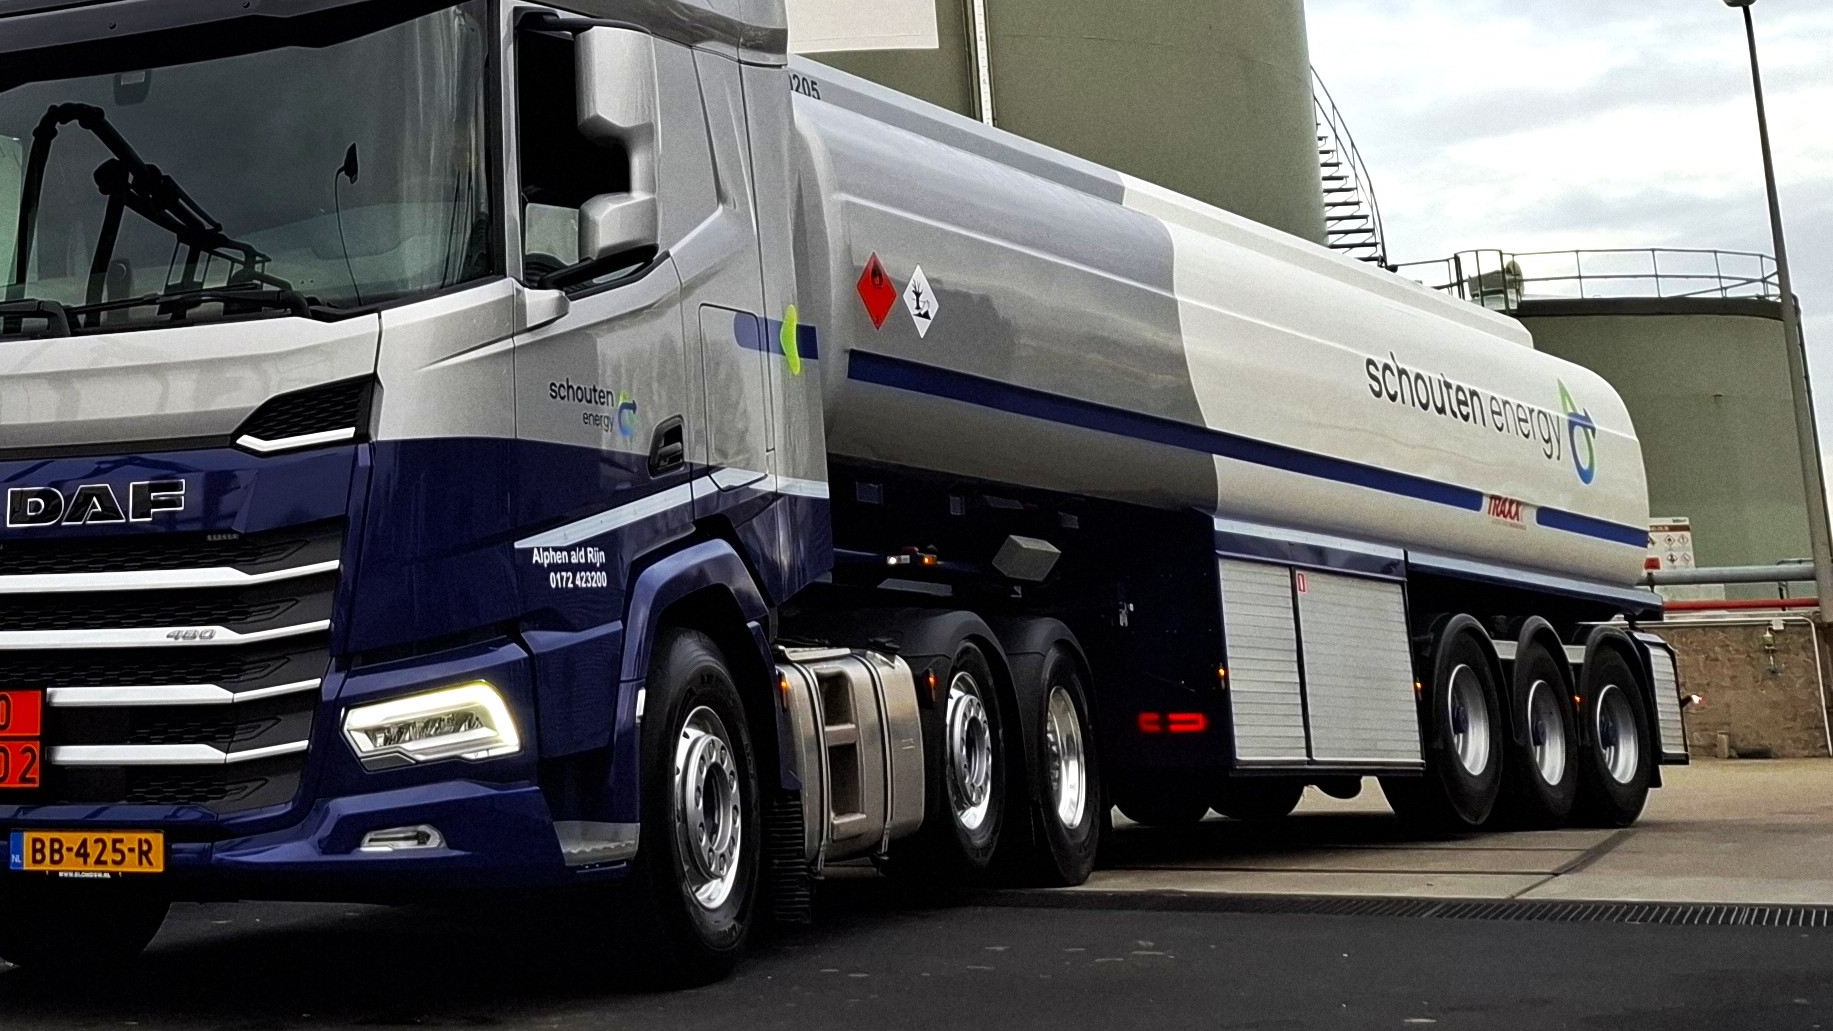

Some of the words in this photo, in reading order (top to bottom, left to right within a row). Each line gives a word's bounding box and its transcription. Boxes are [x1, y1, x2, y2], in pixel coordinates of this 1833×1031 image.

[789, 74, 821, 100] 205
[549, 378, 614, 407] schouten
[1364, 351, 1487, 428] schouten
[1489, 393, 1561, 461] energy
[582, 411, 614, 432] energy
[7, 479, 185, 527] DAF
[532, 547, 568, 568] Alphen
[570, 546, 585, 564] a/d
[586, 547, 606, 567] Rijn
[549, 571, 573, 588] 0172
[575, 570, 607, 588] 423200
[166, 629, 216, 640] 480
[11, 854, 21, 863] NL
[31, 837, 154, 866] BB-425-R
